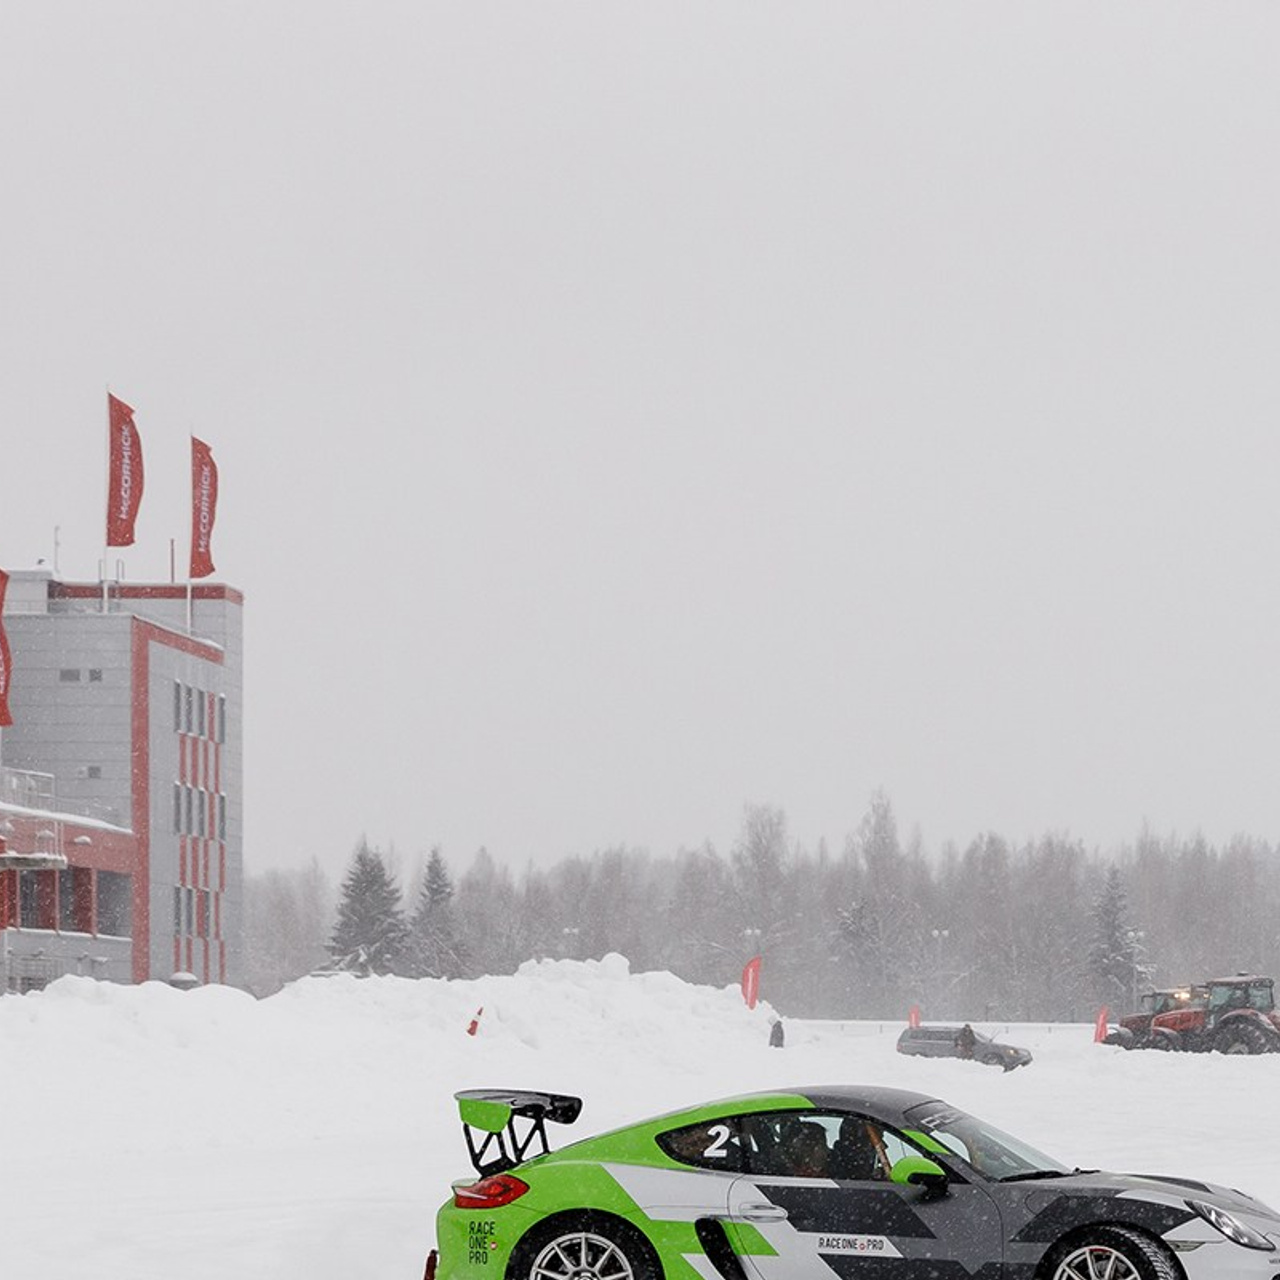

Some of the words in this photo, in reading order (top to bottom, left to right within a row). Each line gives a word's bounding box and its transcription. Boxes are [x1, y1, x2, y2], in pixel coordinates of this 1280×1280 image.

[120, 424, 132, 520] McCORMICK
[703, 1124, 730, 1157] 2
[469, 1221, 495, 1235] RACE
[469, 1235, 487, 1249] ONE
[867, 1239, 884, 1250] PRO
[469, 1251, 487, 1265] PRO
